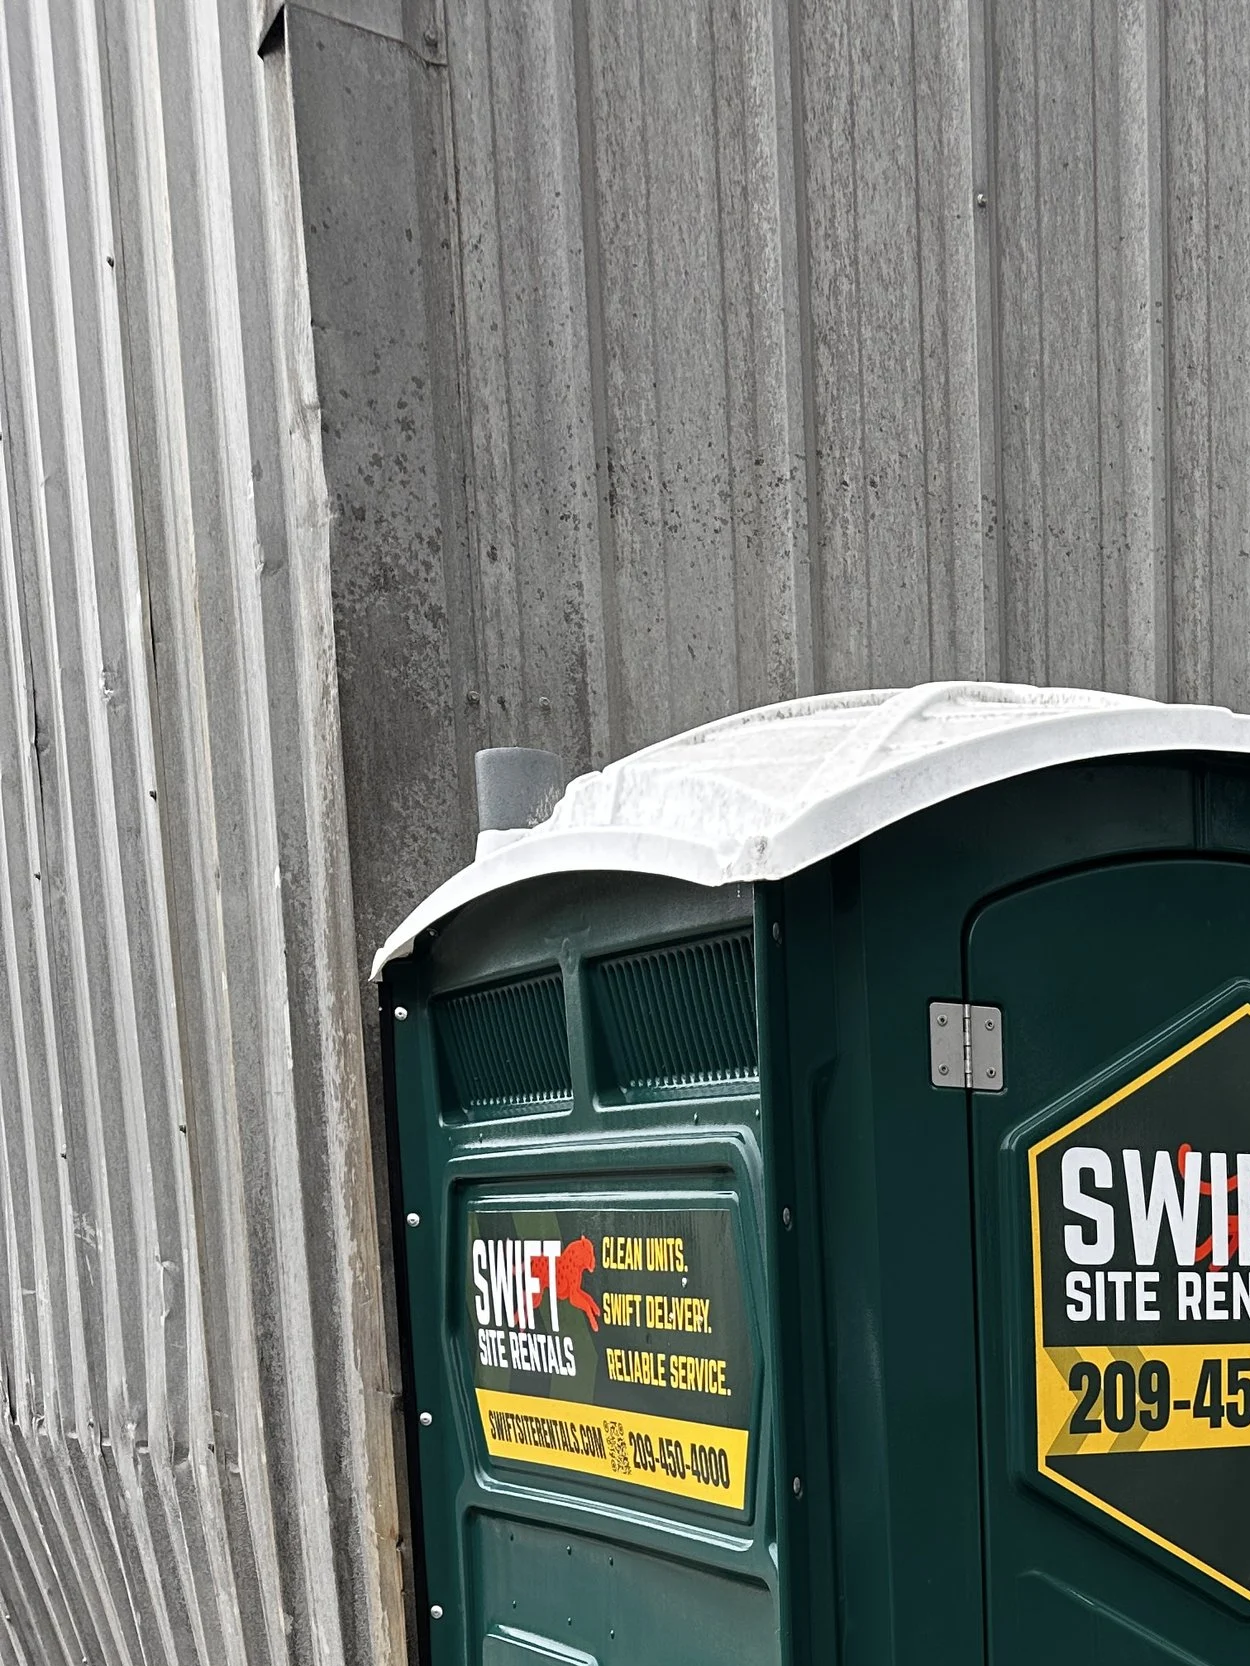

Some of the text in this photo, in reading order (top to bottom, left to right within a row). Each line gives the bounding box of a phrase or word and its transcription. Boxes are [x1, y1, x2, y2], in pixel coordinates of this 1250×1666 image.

[602, 1236, 688, 1273] CLEAN UNITS.
[472, 1239, 561, 1332] SWIFT
[1066, 1270, 1160, 1322] SITE
[602, 1292, 712, 1334] SWIFT DELIVERY.
[478, 1328, 576, 1377] SITE RENTALS
[606, 1348, 731, 1396] RELIABLE SERVICE.
[488, 1409, 607, 1460] SWIFTSITERENTALS.COM
[628, 1432, 730, 1489] 209-450-4000
